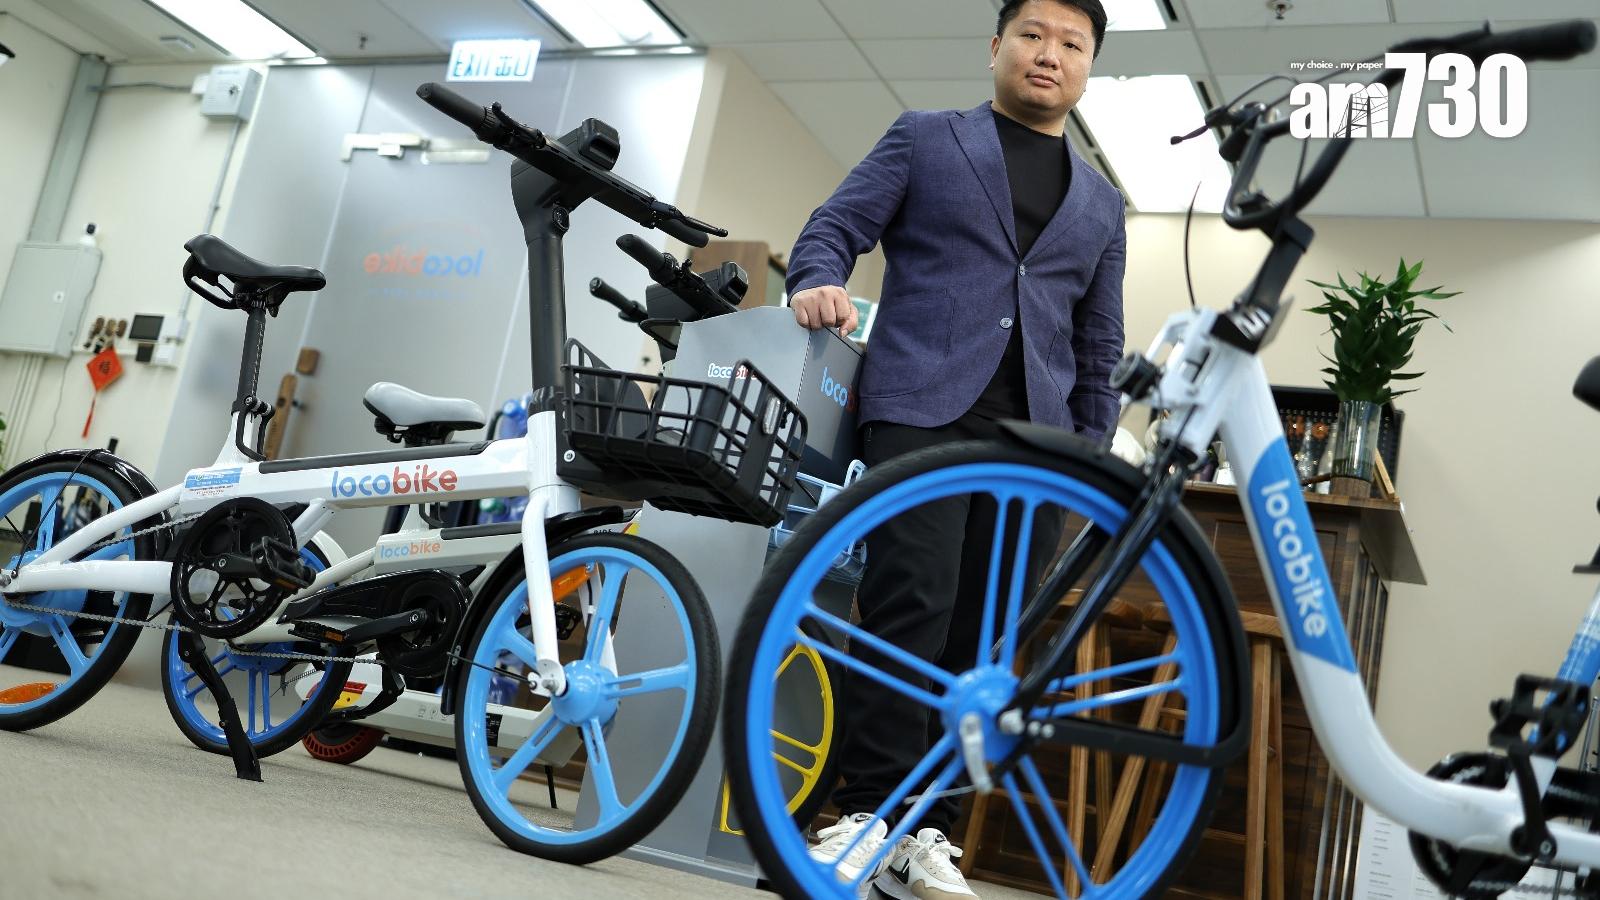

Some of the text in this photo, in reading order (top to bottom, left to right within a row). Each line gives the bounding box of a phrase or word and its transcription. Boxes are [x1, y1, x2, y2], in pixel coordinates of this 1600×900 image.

[331, 464, 458, 498] locobike
[380, 541, 441, 559] locobike
[1260, 478, 1327, 639] locobike
